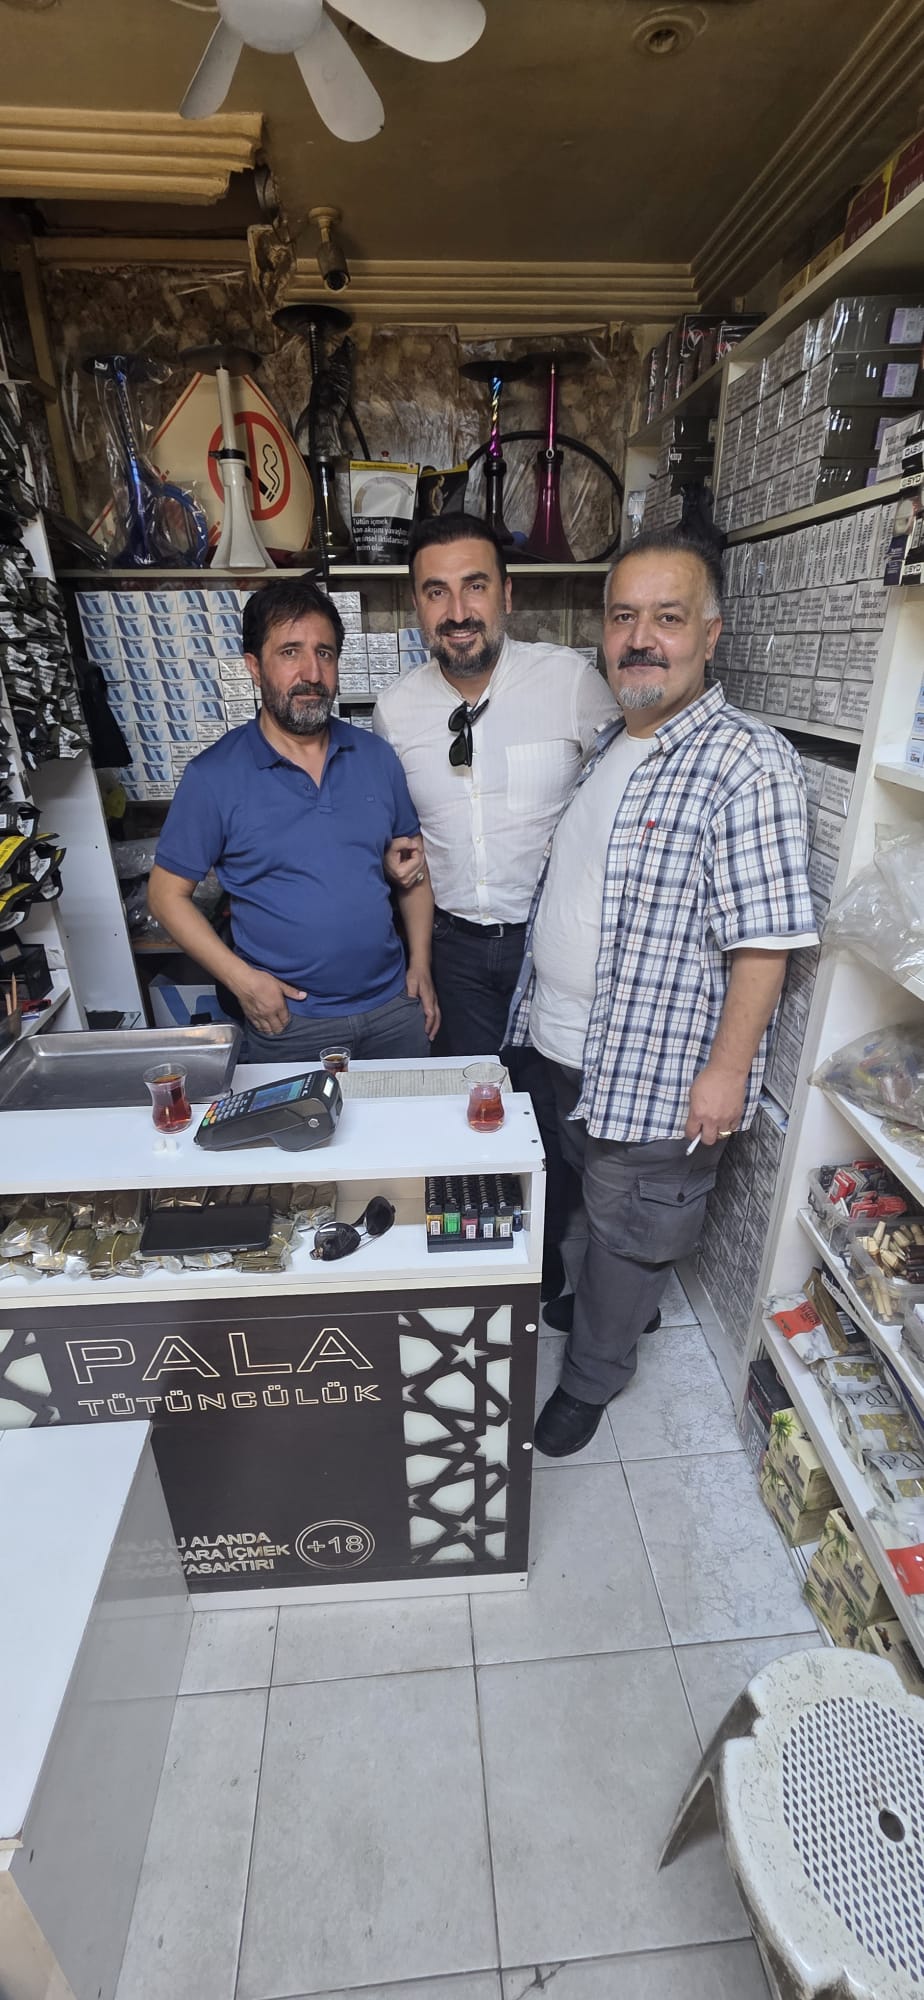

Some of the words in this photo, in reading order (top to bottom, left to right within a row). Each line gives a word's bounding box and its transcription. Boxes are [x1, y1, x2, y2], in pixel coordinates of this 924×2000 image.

[65, 1327, 374, 1385] PALA
[77, 1381, 382, 1417] TÜTÜNCÜLÜK
[190, 1531, 272, 1548] ALANDA
[306, 1535, 364, 1554] +18
[226, 1543, 291, 1561] İÇMEK
